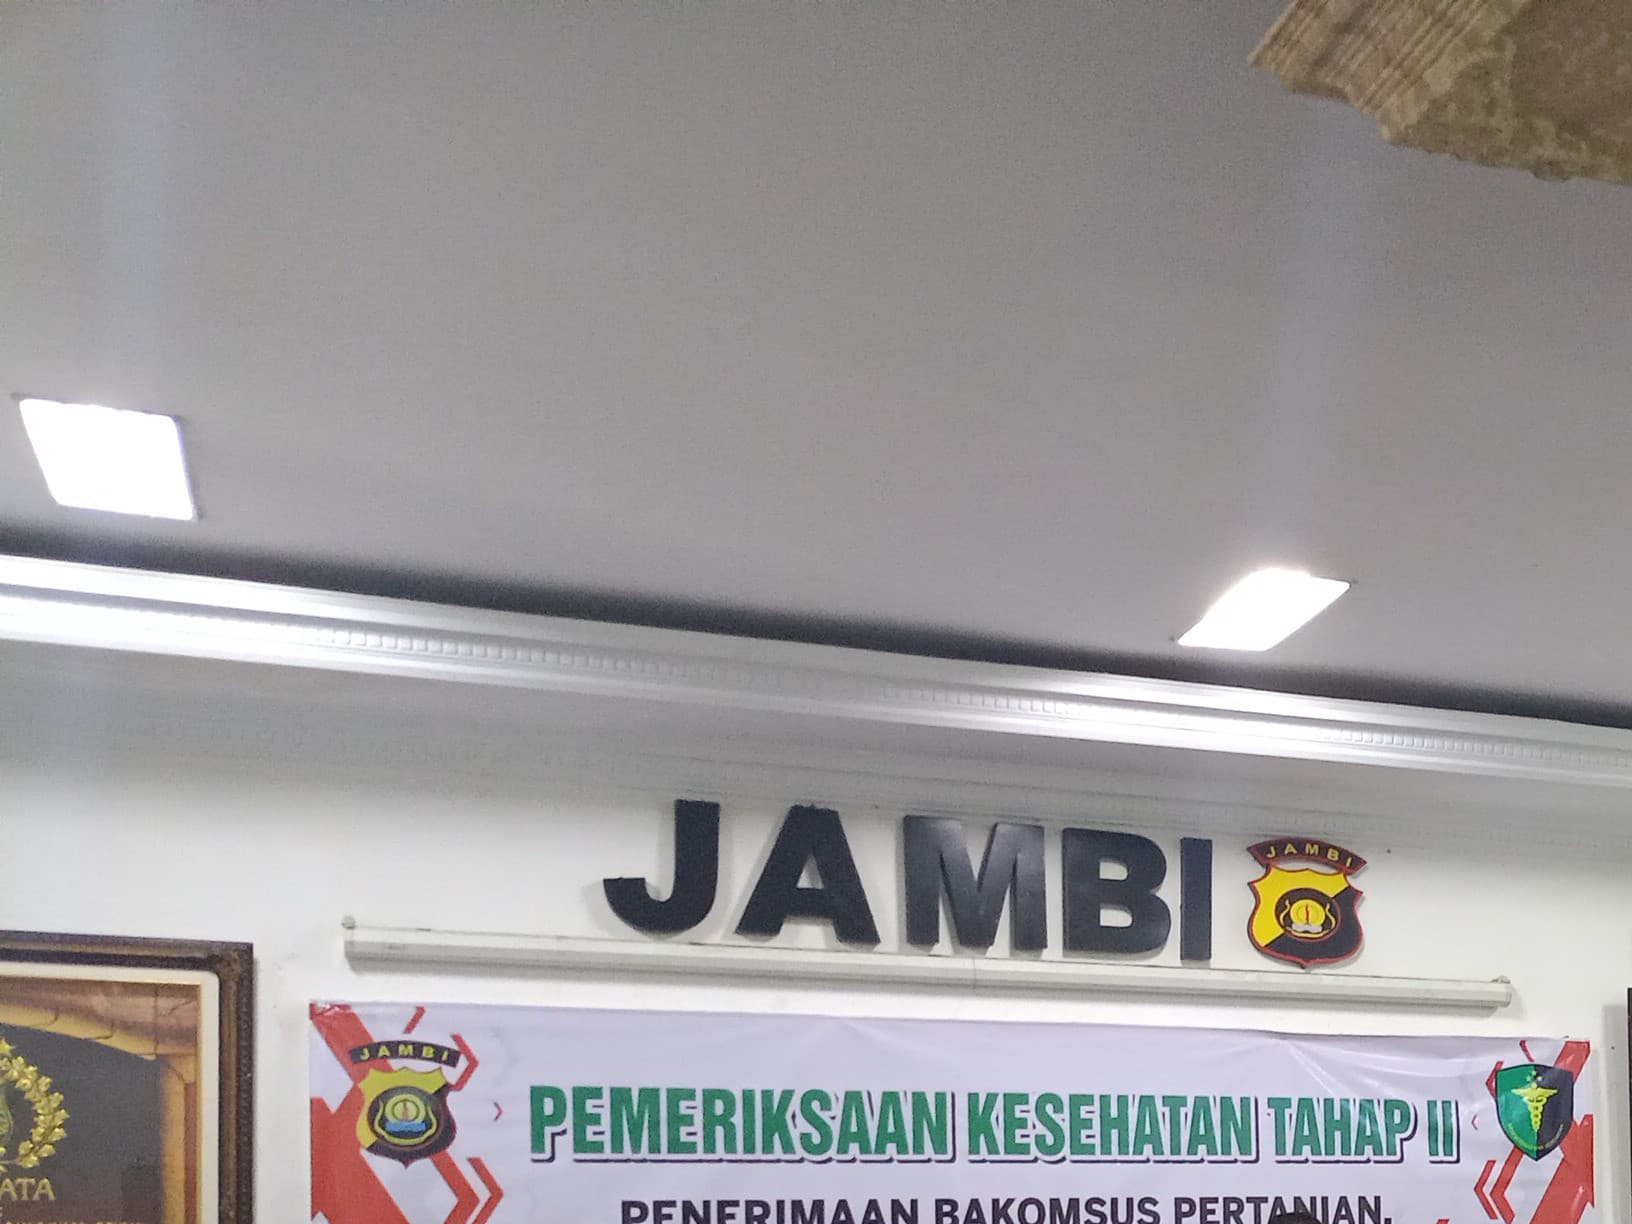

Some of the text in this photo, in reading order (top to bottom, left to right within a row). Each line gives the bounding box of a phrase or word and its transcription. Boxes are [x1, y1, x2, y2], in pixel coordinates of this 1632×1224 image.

[1266, 842, 1352, 868] JAMBI
[603, 799, 1213, 961] JAMBI
[360, 1043, 449, 1061] JAMBI
[529, 1085, 952, 1160] PEMERIKSAAN
[967, 1091, 1257, 1161] KESEHATAN
[1266, 1096, 1415, 1161] TAHAP
[1426, 1099, 1459, 1161] II
[0, 1178, 56, 1201] ATA
